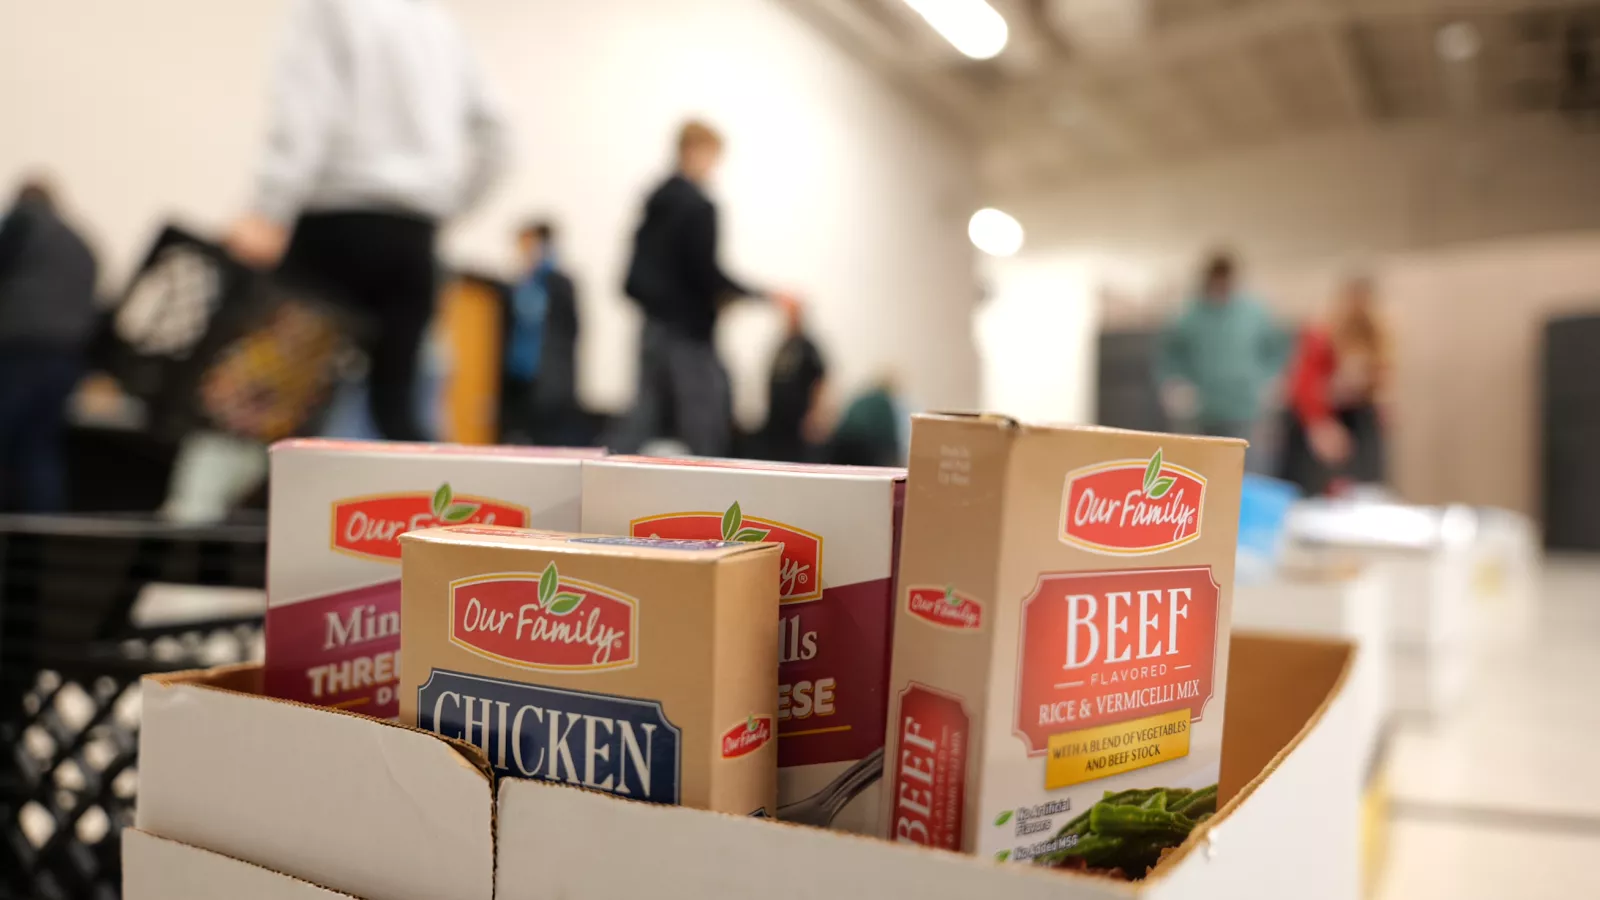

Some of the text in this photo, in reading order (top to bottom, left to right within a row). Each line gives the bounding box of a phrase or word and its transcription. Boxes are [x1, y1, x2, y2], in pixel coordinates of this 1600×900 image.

[345, 511, 404, 543] Our
[1074, 487, 1196, 542] Our Family
[911, 593, 935, 611] Our
[463, 597, 625, 665] Our Family
[1062, 587, 1193, 672] BEEF
[1090, 664, 1168, 687] FLAVORED
[1038, 679, 1200, 726] RICE & VERMICELLI MIX
[433, 690, 658, 798] CHICKEN
[1052, 744, 1080, 760] WITH
[1090, 735, 1121, 753] BLEND
[1122, 731, 1137, 746] OF
[1136, 719, 1187, 742] VEGETABLES
[1085, 744, 1161, 773] AND BEEF STOCK
[896, 716, 936, 845] BEEF
